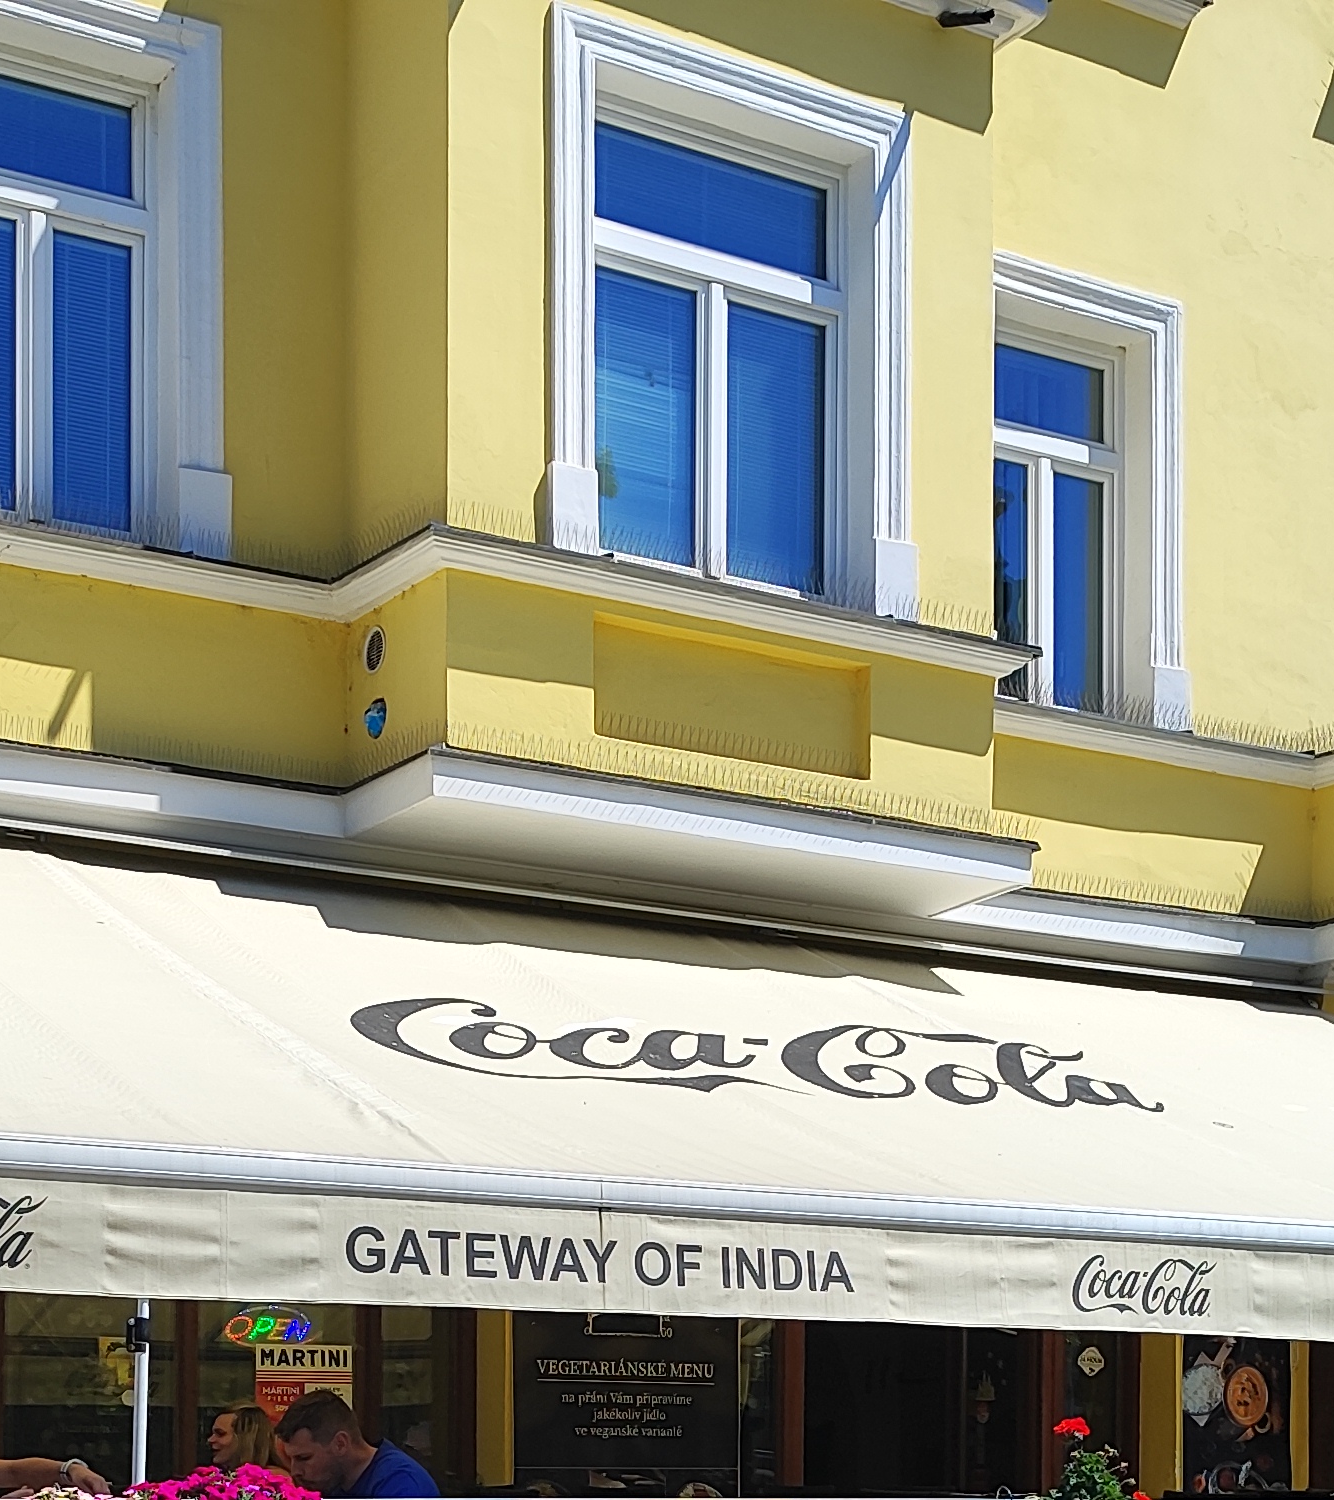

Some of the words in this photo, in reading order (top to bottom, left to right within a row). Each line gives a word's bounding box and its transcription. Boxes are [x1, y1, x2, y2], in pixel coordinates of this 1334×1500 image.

[350, 997, 1165, 1112] Coca-Cola
[345, 1225, 618, 1284] GATEWAY
[634, 1241, 703, 1288] OF
[721, 1245, 856, 1294] INDIA
[1071, 1254, 1218, 1317] Coca-Cola
[224, 1315, 312, 1342] OPEN
[260, 1347, 348, 1368] MARTINI
[536, 1357, 667, 1378] VEGETARIÁNSKÉ
[669, 1363, 715, 1379] MENU
[262, 1386, 300, 1396] MARTINI
[561, 1394, 575, 1404] na
[610, 1391, 633, 1405] Vám
[592, 1408, 642, 1423] jakékoliv
[574, 1426, 588, 1436] ve
[590, 1425, 639, 1439] veganské
